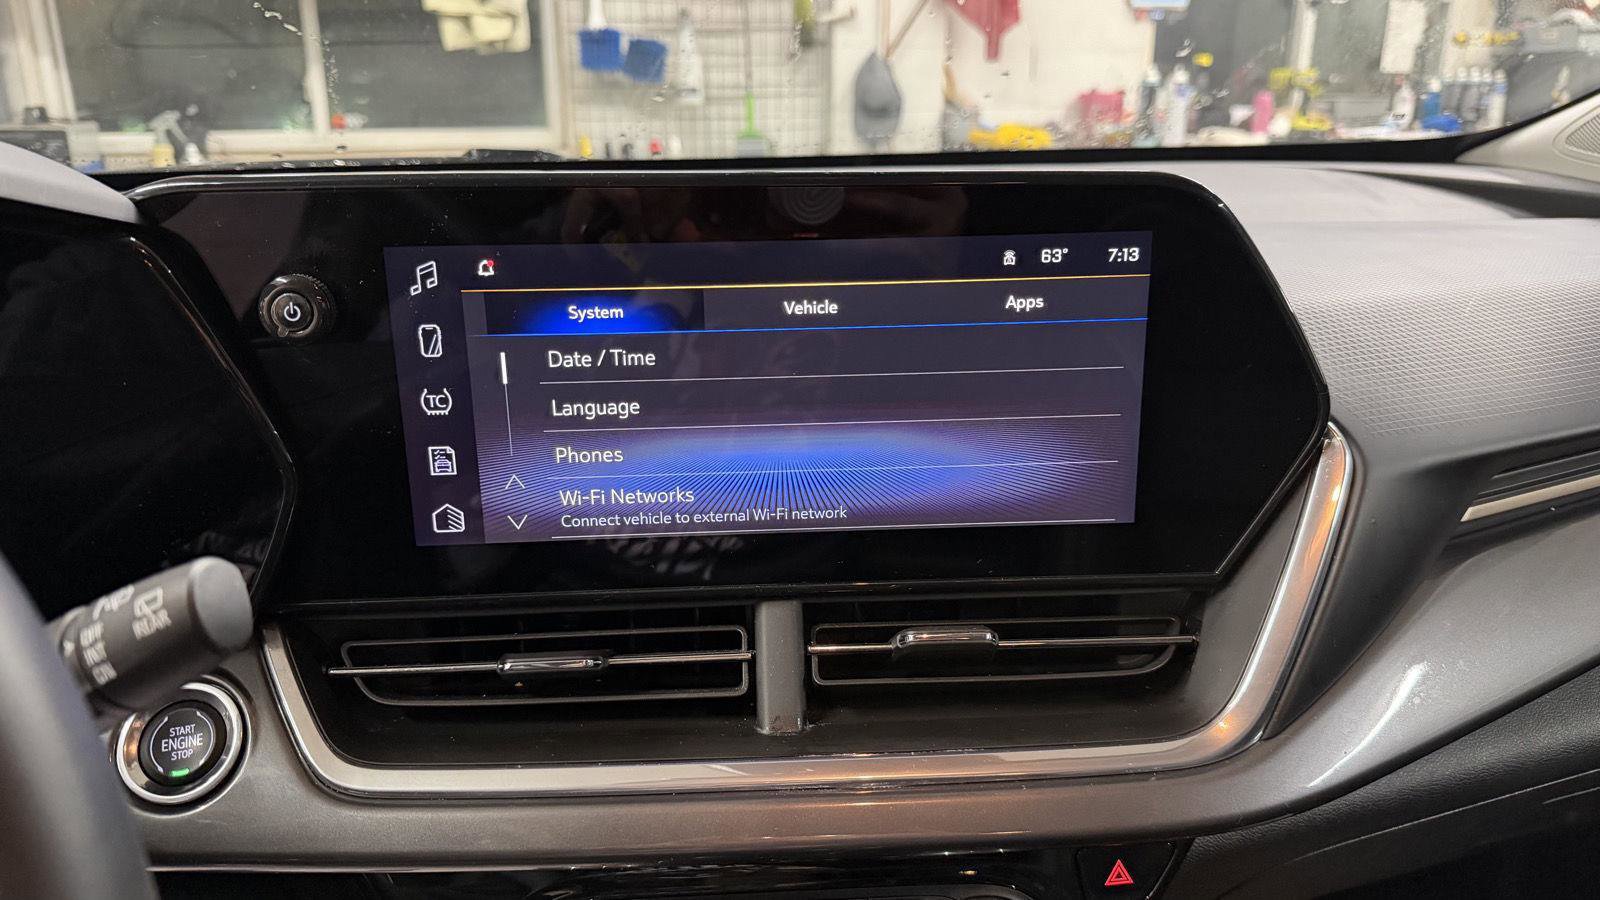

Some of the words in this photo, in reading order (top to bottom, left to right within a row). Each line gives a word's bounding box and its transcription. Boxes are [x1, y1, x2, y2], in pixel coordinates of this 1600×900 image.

[1041, 248, 1069, 263] 63°
[1108, 248, 1140, 263] 7:13
[784, 300, 838, 316] Vehicle
[1005, 295, 1044, 312] Apps
[568, 305, 624, 321] System
[548, 351, 592, 368] Date
[597, 350, 606, 367] /
[609, 350, 656, 367] Time
[425, 394, 447, 408] TC
[551, 399, 641, 420] Language
[555, 446, 624, 464] Phones
[559, 489, 605, 506] Wi-Fi
[611, 487, 695, 504] Networks
[561, 514, 620, 528] Connect
[623, 512, 672, 526] vehicle
[675, 513, 690, 525] to
[693, 508, 750, 524] external
[752, 507, 789, 521] Wi-Fi
[791, 505, 848, 520] network
[169, 723, 196, 737] START
[161, 732, 203, 752] ENGINE
[171, 749, 194, 761] STOP
